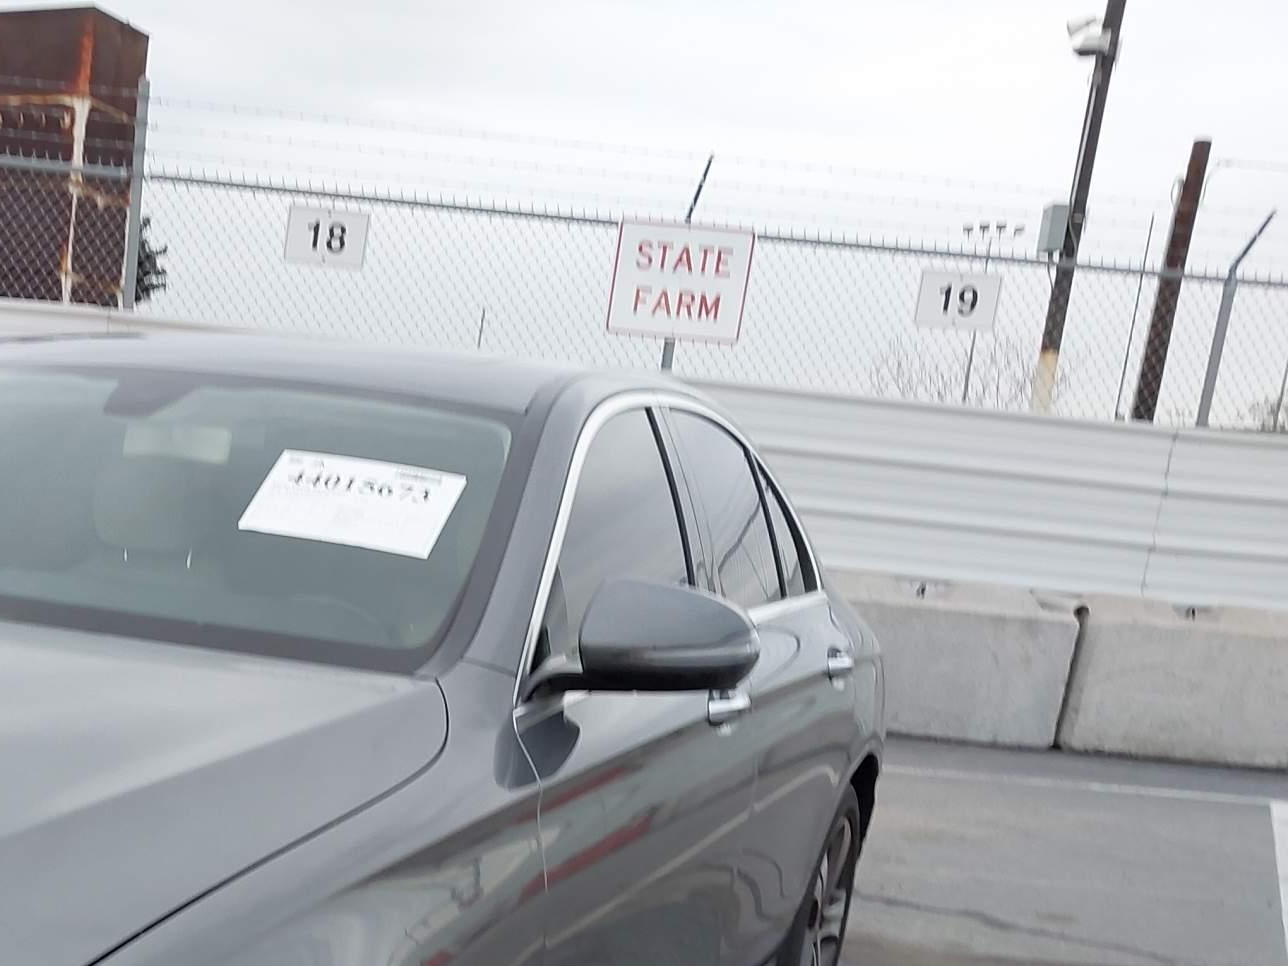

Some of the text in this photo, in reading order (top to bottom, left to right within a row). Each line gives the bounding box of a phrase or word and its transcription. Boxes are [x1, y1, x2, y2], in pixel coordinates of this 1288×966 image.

[307, 219, 347, 255] 18
[635, 239, 734, 279] STATE
[632, 285, 722, 325] FARM
[939, 282, 979, 318] 19
